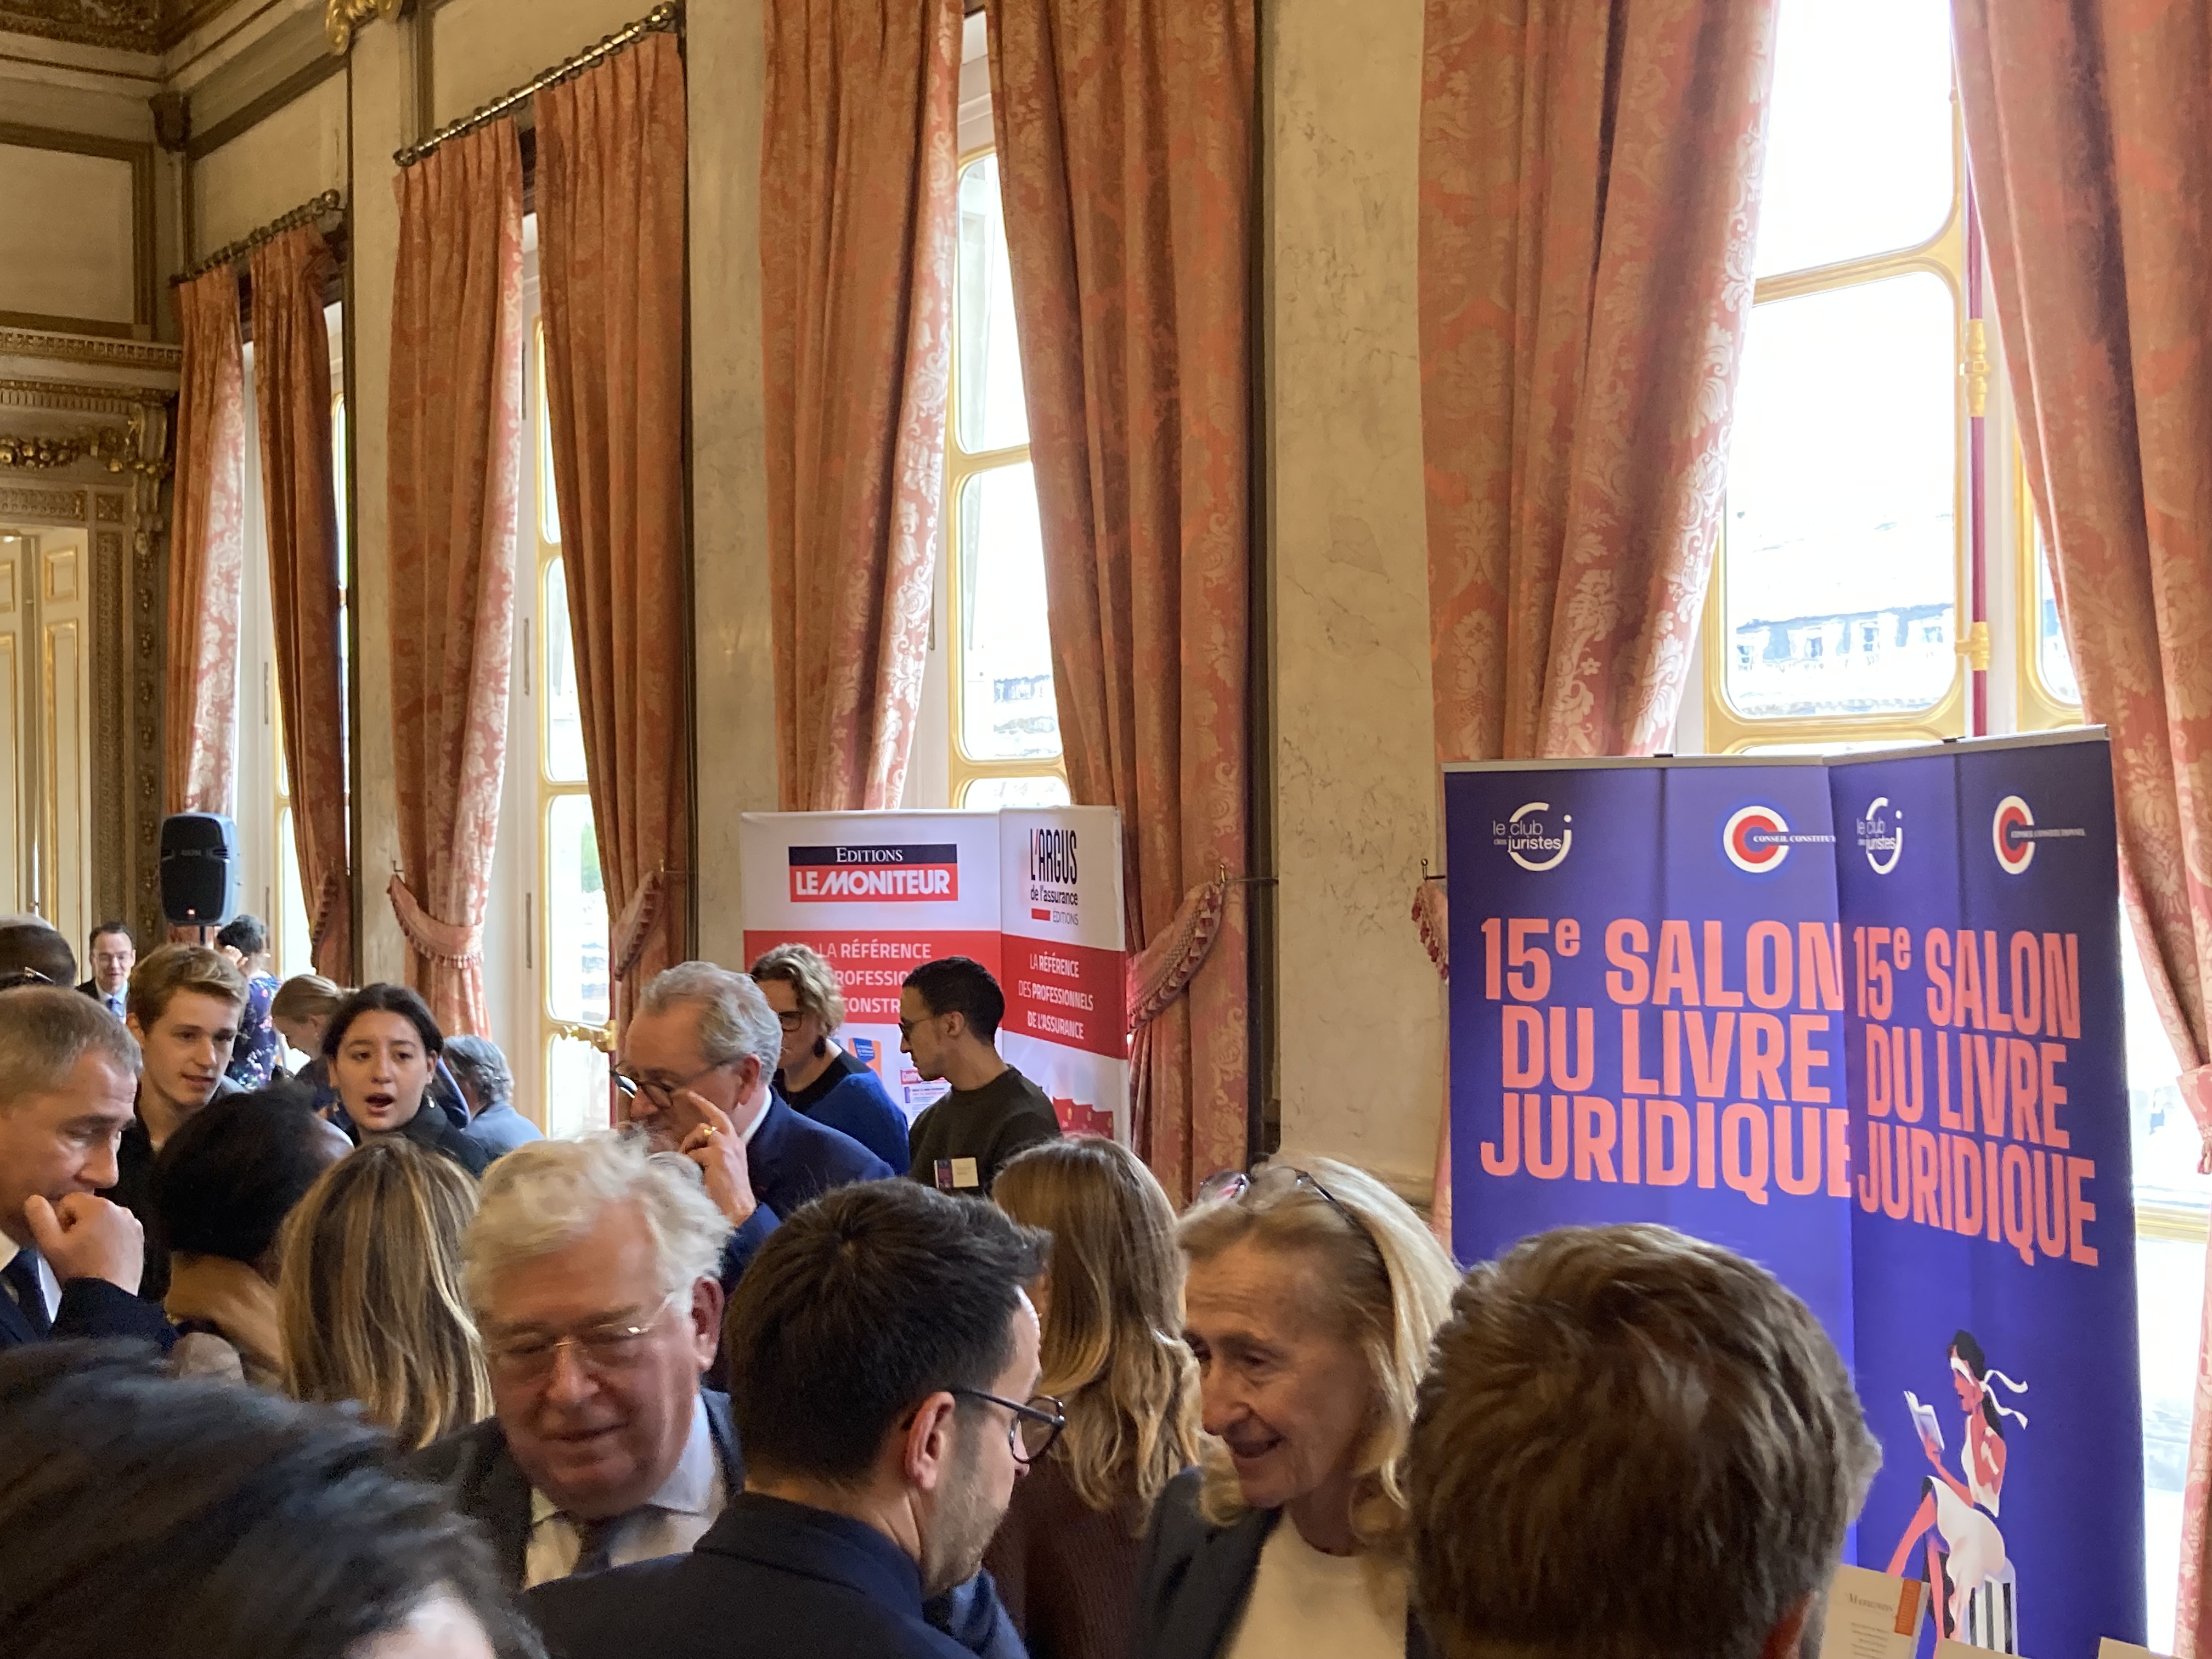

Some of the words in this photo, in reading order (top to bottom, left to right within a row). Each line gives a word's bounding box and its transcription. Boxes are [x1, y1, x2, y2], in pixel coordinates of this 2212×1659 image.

[1493, 820, 1505, 836] le
[1510, 820, 1543, 836] club
[1030, 828, 1077, 884] L'ARGUS
[1507, 836, 1562, 853] juristes
[796, 871, 820, 895] LE
[819, 870, 950, 895] MONITEUR
[1031, 884, 1039, 901] de
[1040, 885, 1078, 906] l'assurance
[819, 943, 837, 958] LA
[840, 938, 932, 958] RÉFÉRENCE
[834, 970, 909, 985] ROFESSIO
[1030, 953, 1039, 970] LA
[1039, 951, 1080, 978] RÉFÉRENCE
[1604, 919, 1844, 1011] SALON
[1018, 979, 1032, 998] DES
[1031, 983, 1094, 1012] PROFESSIONNELS
[1925, 927, 2081, 1040] SALON
[1028, 1010, 1037, 1029] DE
[1037, 1013, 1085, 1040] L'ASSURANCE
[1502, 1005, 1594, 1093] DU
[1622, 1008, 1831, 1104] LIVRE
[1866, 1024, 1925, 1124] DU
[1939, 1033, 2070, 1149] LIVRE
[1480, 1093, 1852, 1206] JURIDIQUE
[1858, 1120, 2099, 1267] JURIDIQUE
